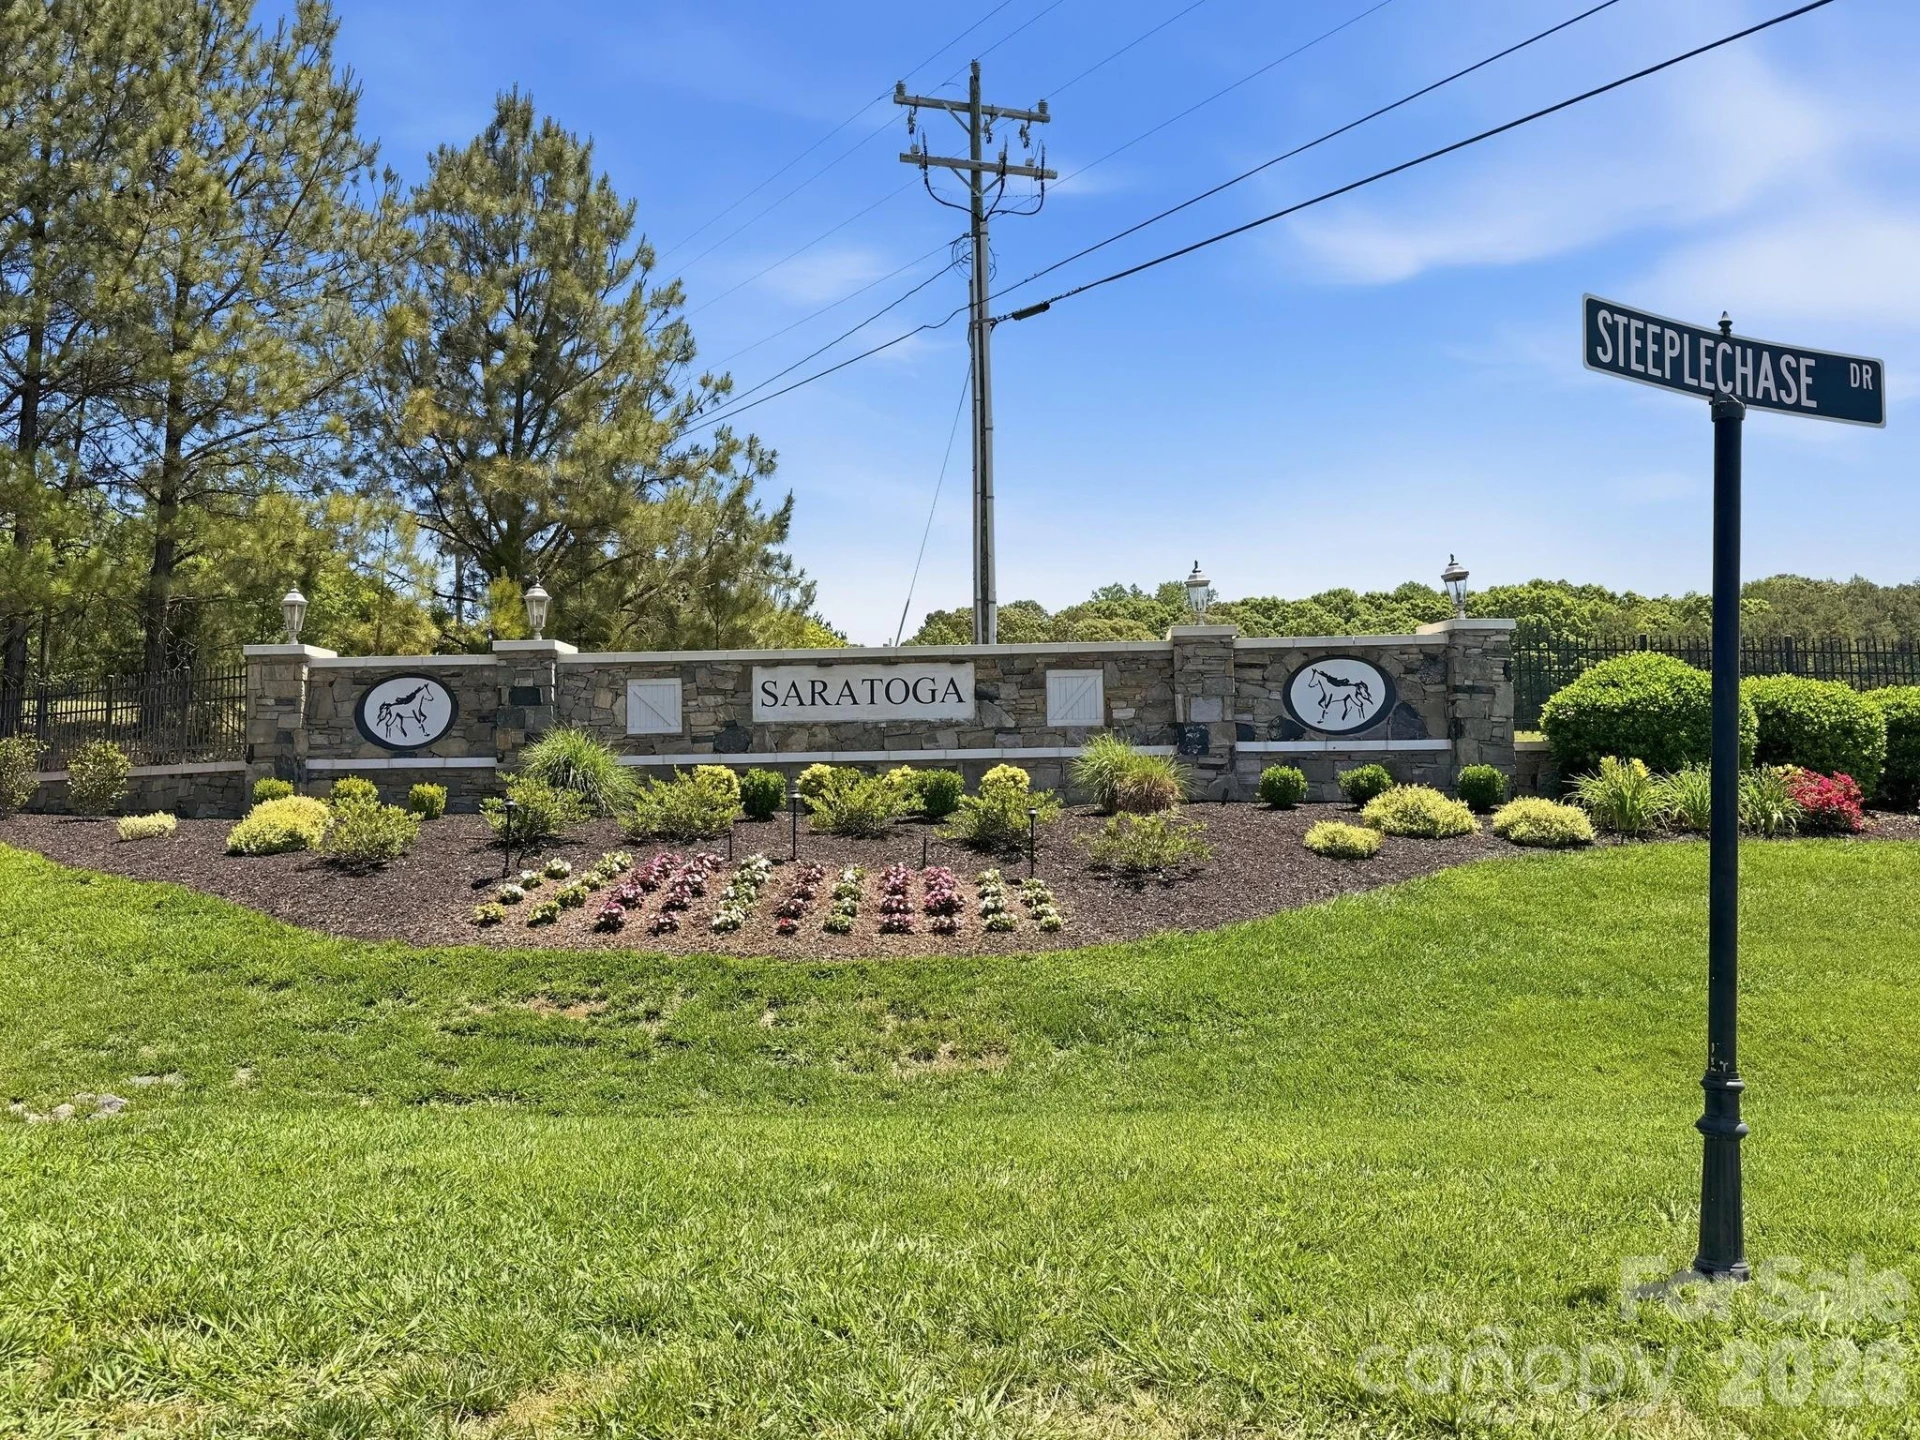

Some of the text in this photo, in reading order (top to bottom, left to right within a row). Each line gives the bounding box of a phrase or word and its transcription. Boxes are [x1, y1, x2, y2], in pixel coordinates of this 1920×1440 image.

[1597, 309, 1873, 408] STEEPLECHASE DR
[760, 676, 966, 708] SARATOGA
